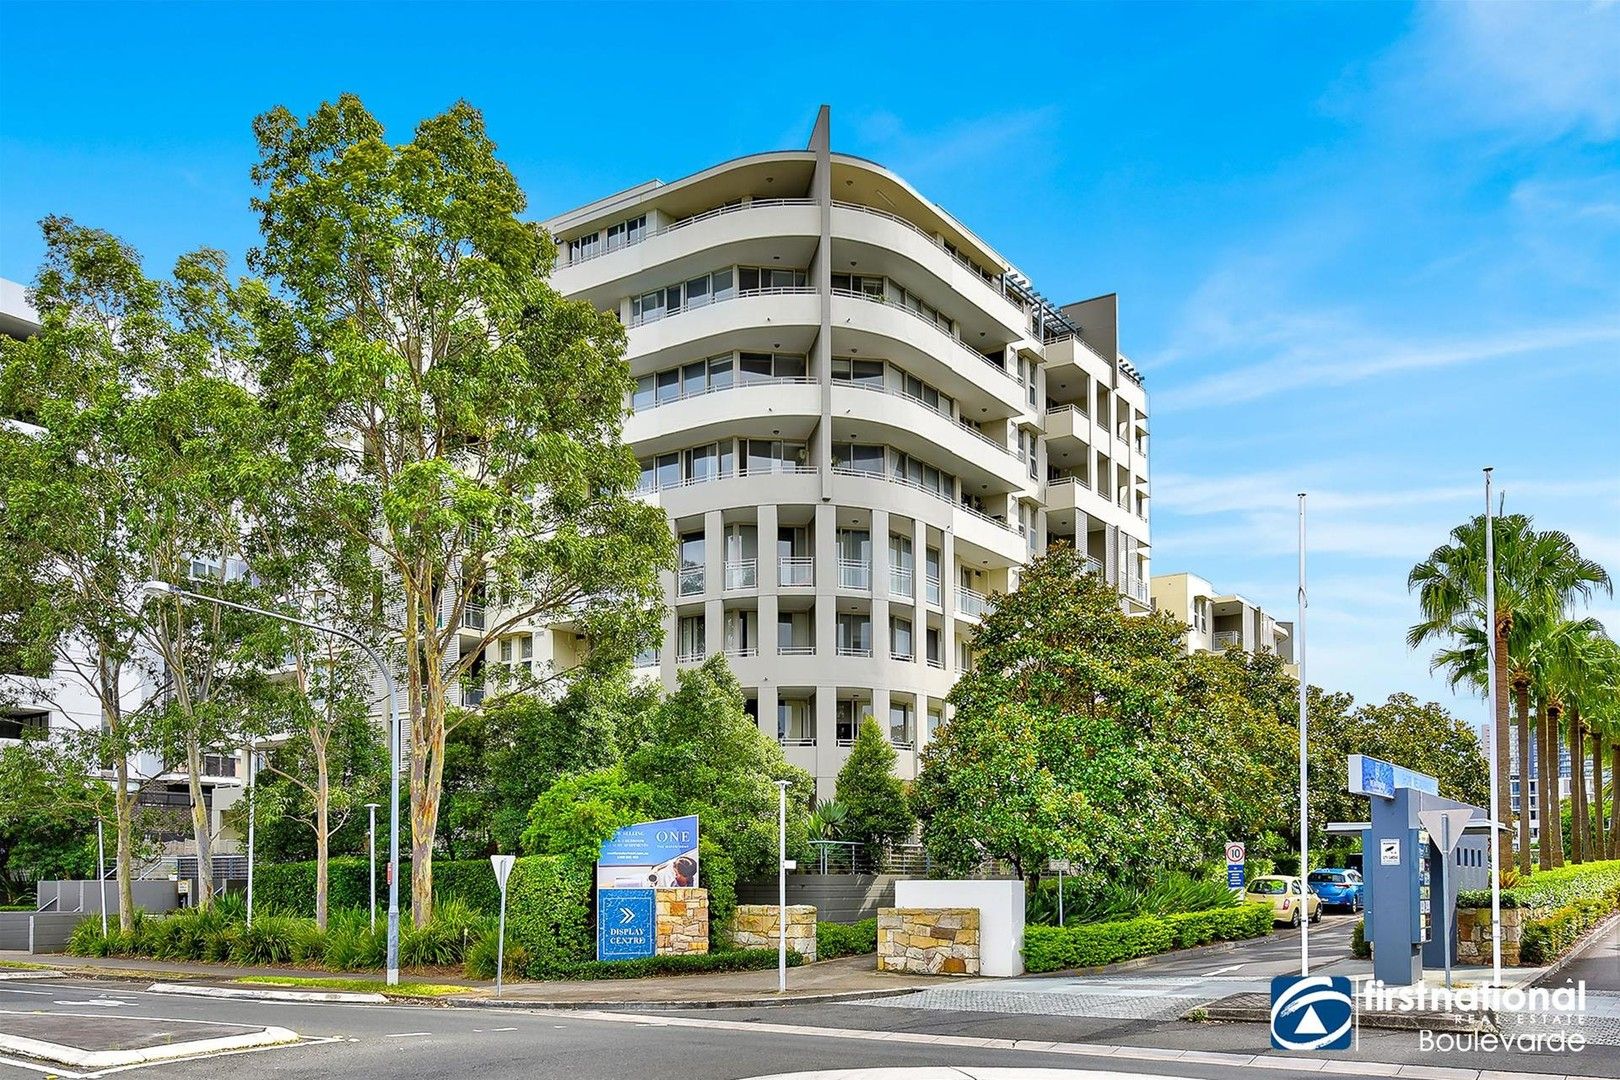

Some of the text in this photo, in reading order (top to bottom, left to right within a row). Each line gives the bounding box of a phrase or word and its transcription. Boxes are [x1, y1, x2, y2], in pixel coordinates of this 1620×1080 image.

[656, 831, 690, 843] ONE
[1231, 849, 1241, 858] 10
[610, 928, 645, 936] DISPLAY
[610, 937, 646, 945] CENTRE
